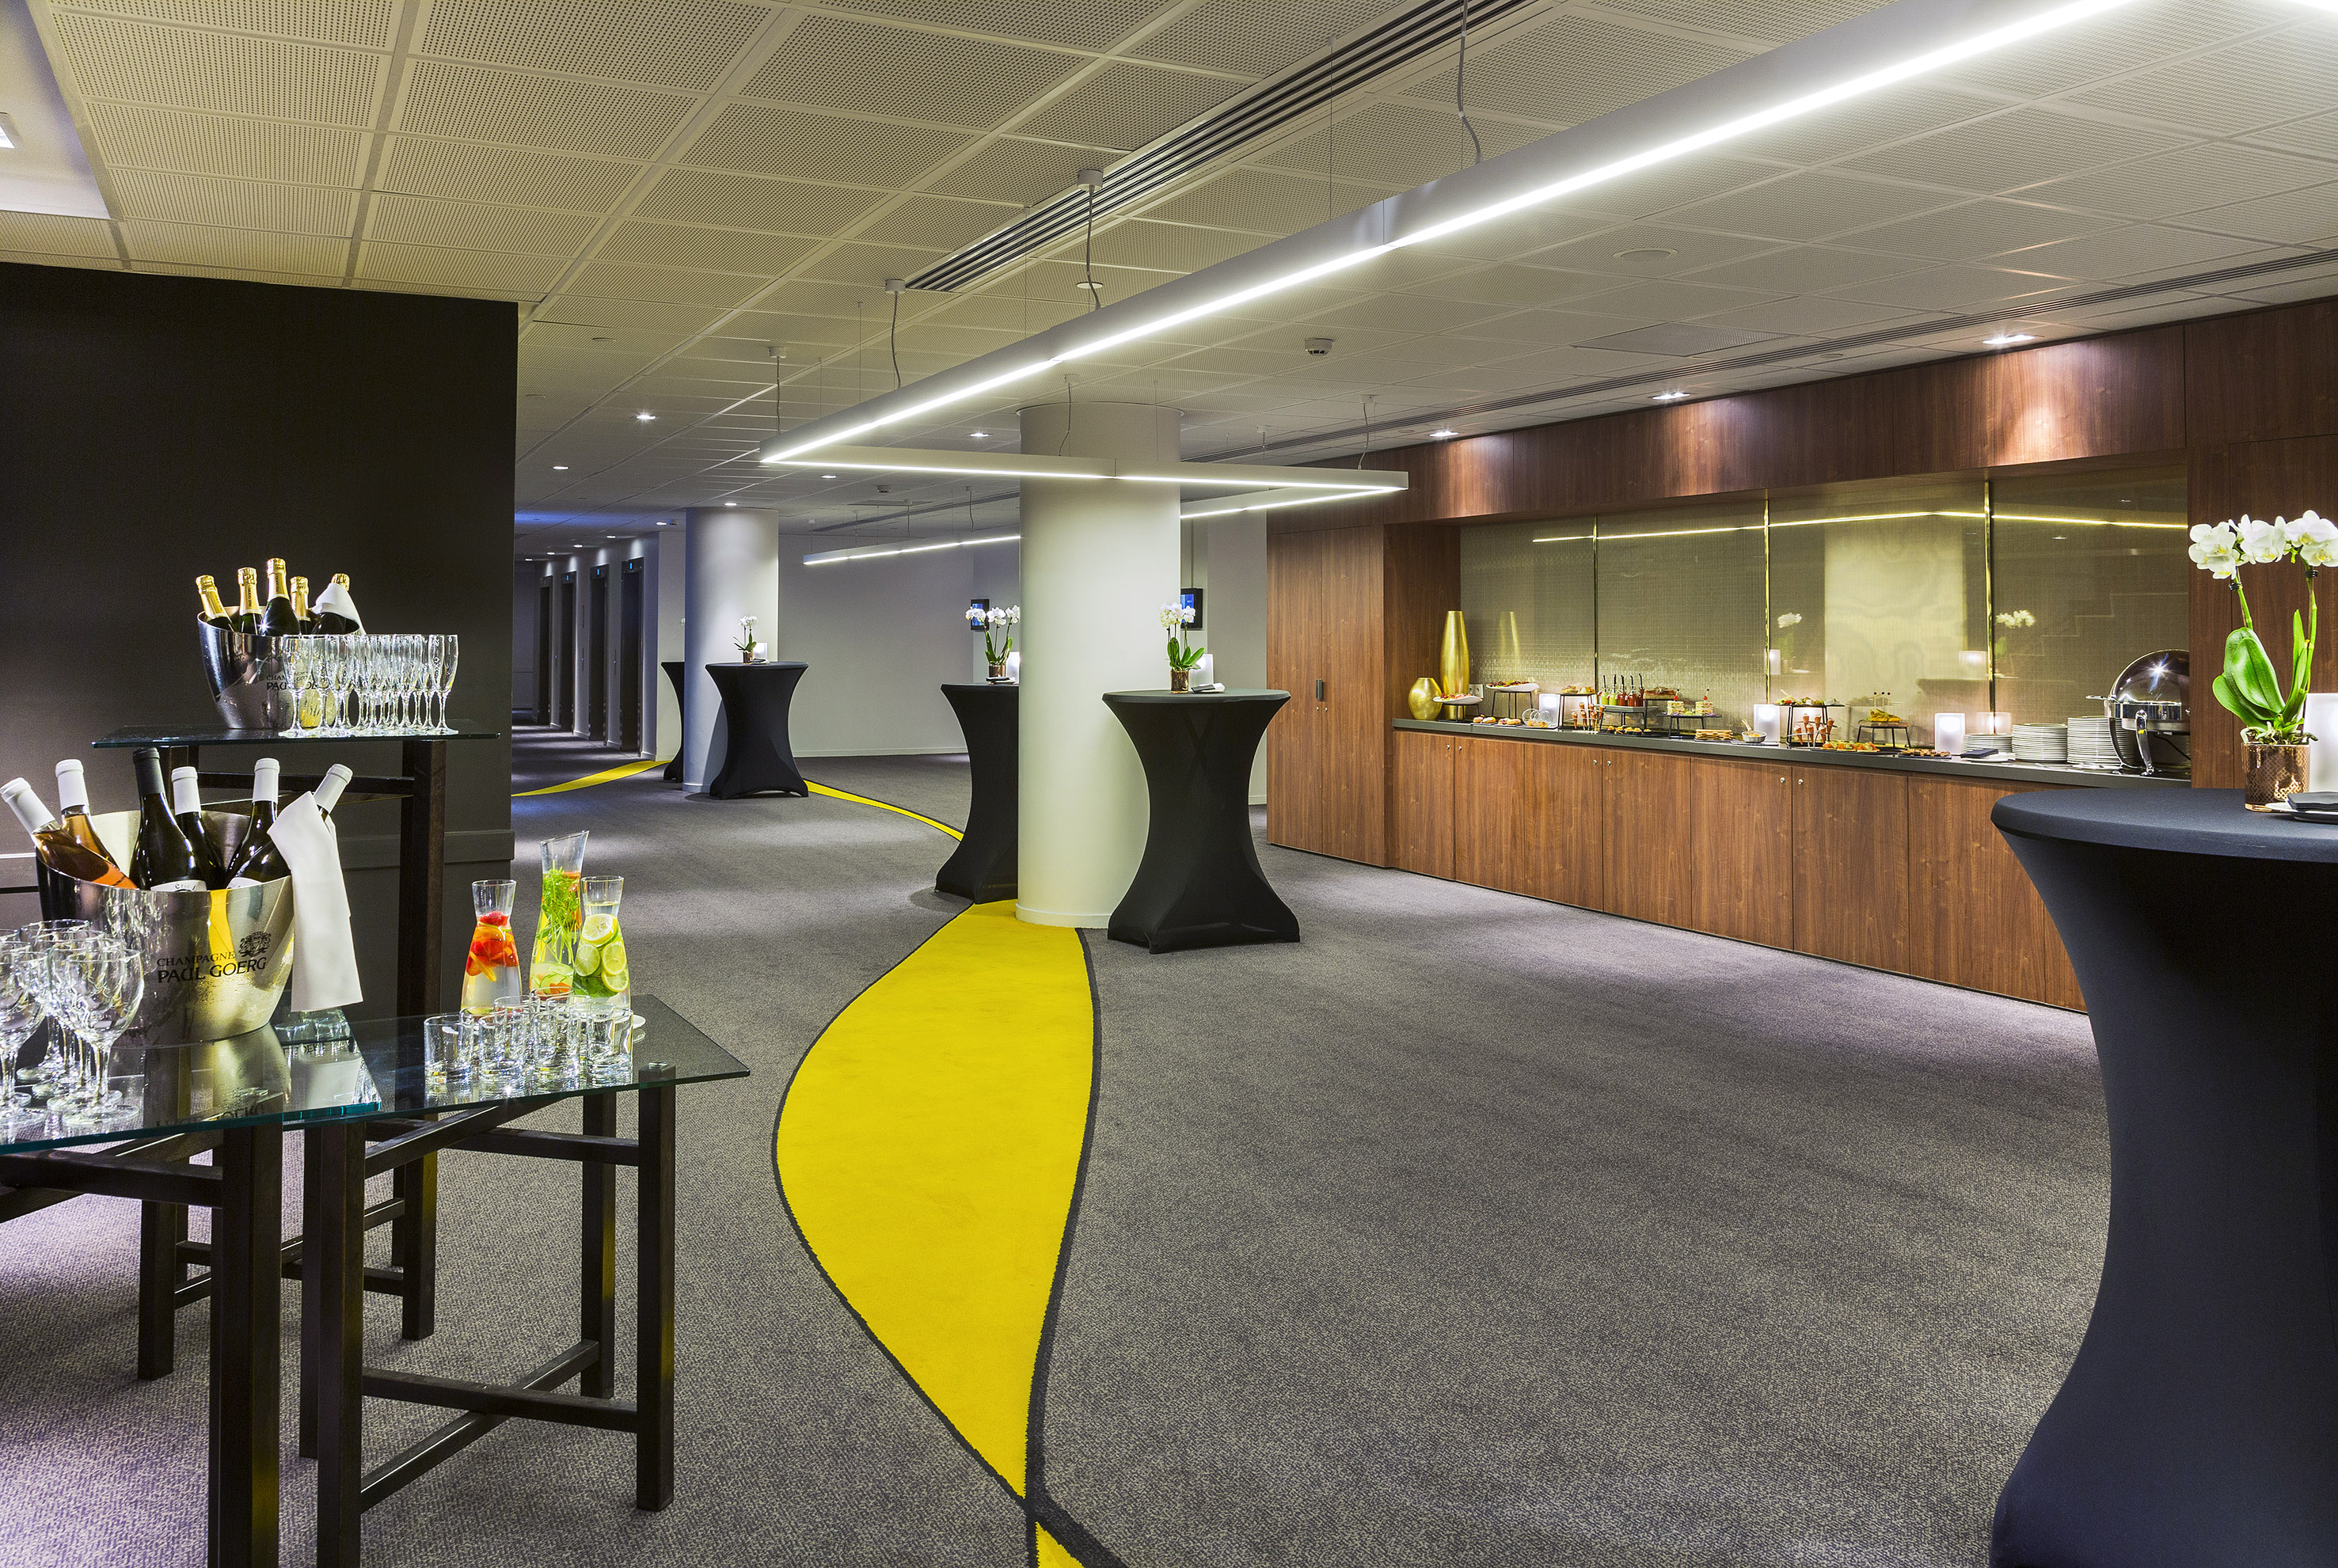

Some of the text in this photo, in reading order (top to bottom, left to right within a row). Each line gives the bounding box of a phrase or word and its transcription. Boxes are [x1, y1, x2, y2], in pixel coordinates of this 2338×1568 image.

[266, 681, 288, 691] PAU
[156, 951, 235, 967] CHAMPAGNE
[157, 956, 268, 984] PAUL GOERG
